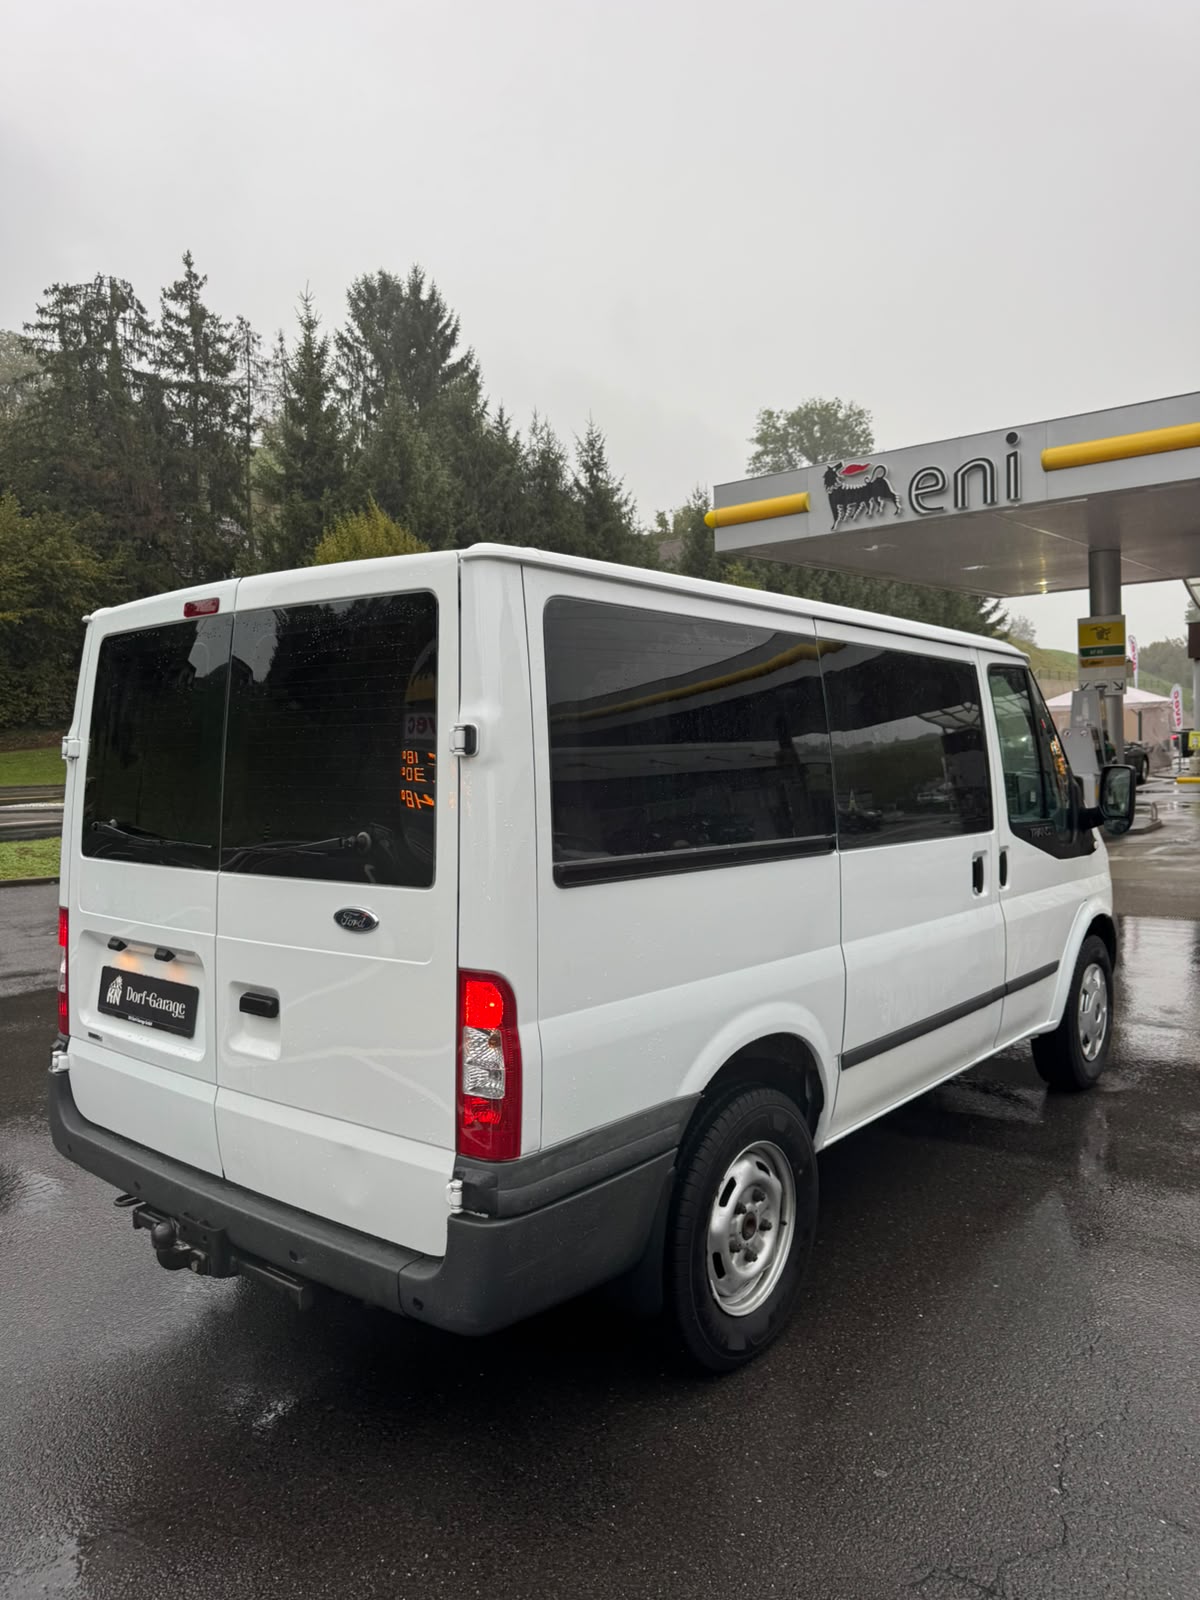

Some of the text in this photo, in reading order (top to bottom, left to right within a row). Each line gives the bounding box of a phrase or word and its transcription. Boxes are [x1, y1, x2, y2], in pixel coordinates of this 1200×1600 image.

[908, 431, 1019, 514] eni
[341, 911, 369, 928] Ford
[126, 986, 186, 1018] Dorf-Garage
